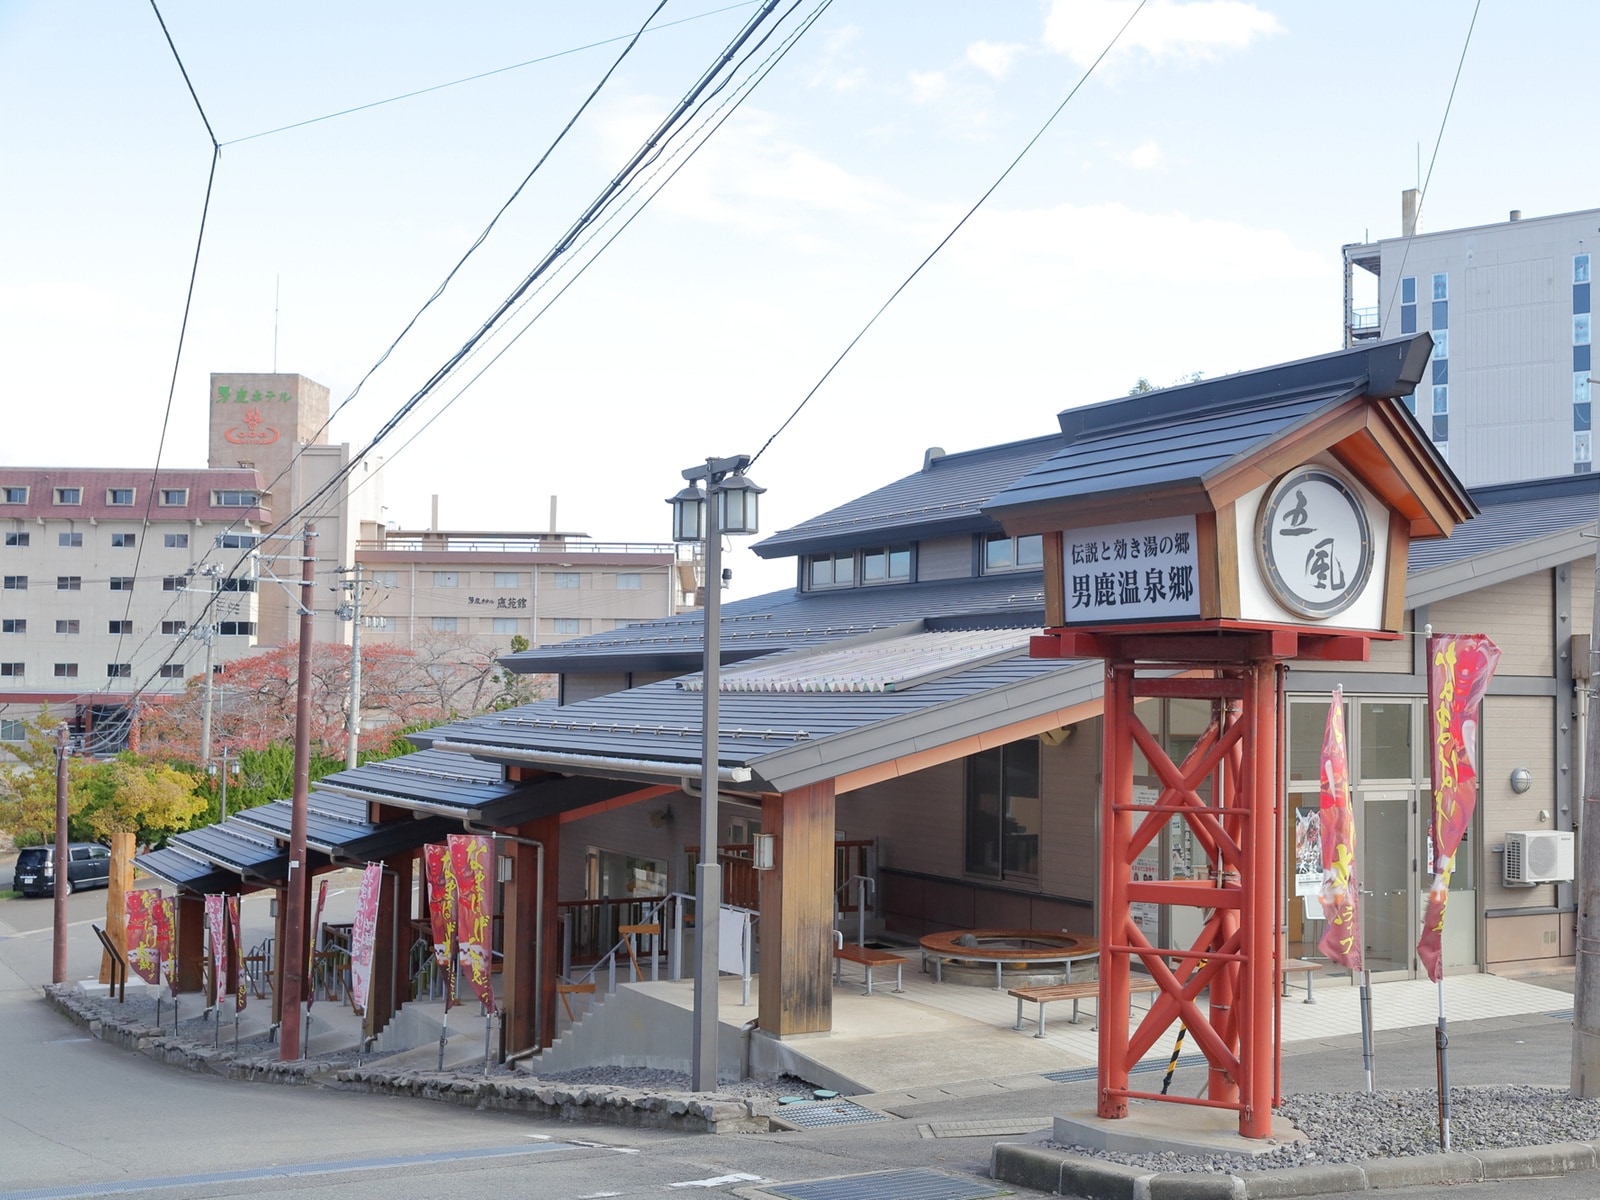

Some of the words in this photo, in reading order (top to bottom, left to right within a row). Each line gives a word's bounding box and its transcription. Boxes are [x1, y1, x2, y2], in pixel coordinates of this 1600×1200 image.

[216, 386, 292, 404] 男鹿ホテル
[1071, 531, 1190, 565] 伝説と効き湯の郷
[1071, 565, 1194, 609] 男鹿温泉郷
